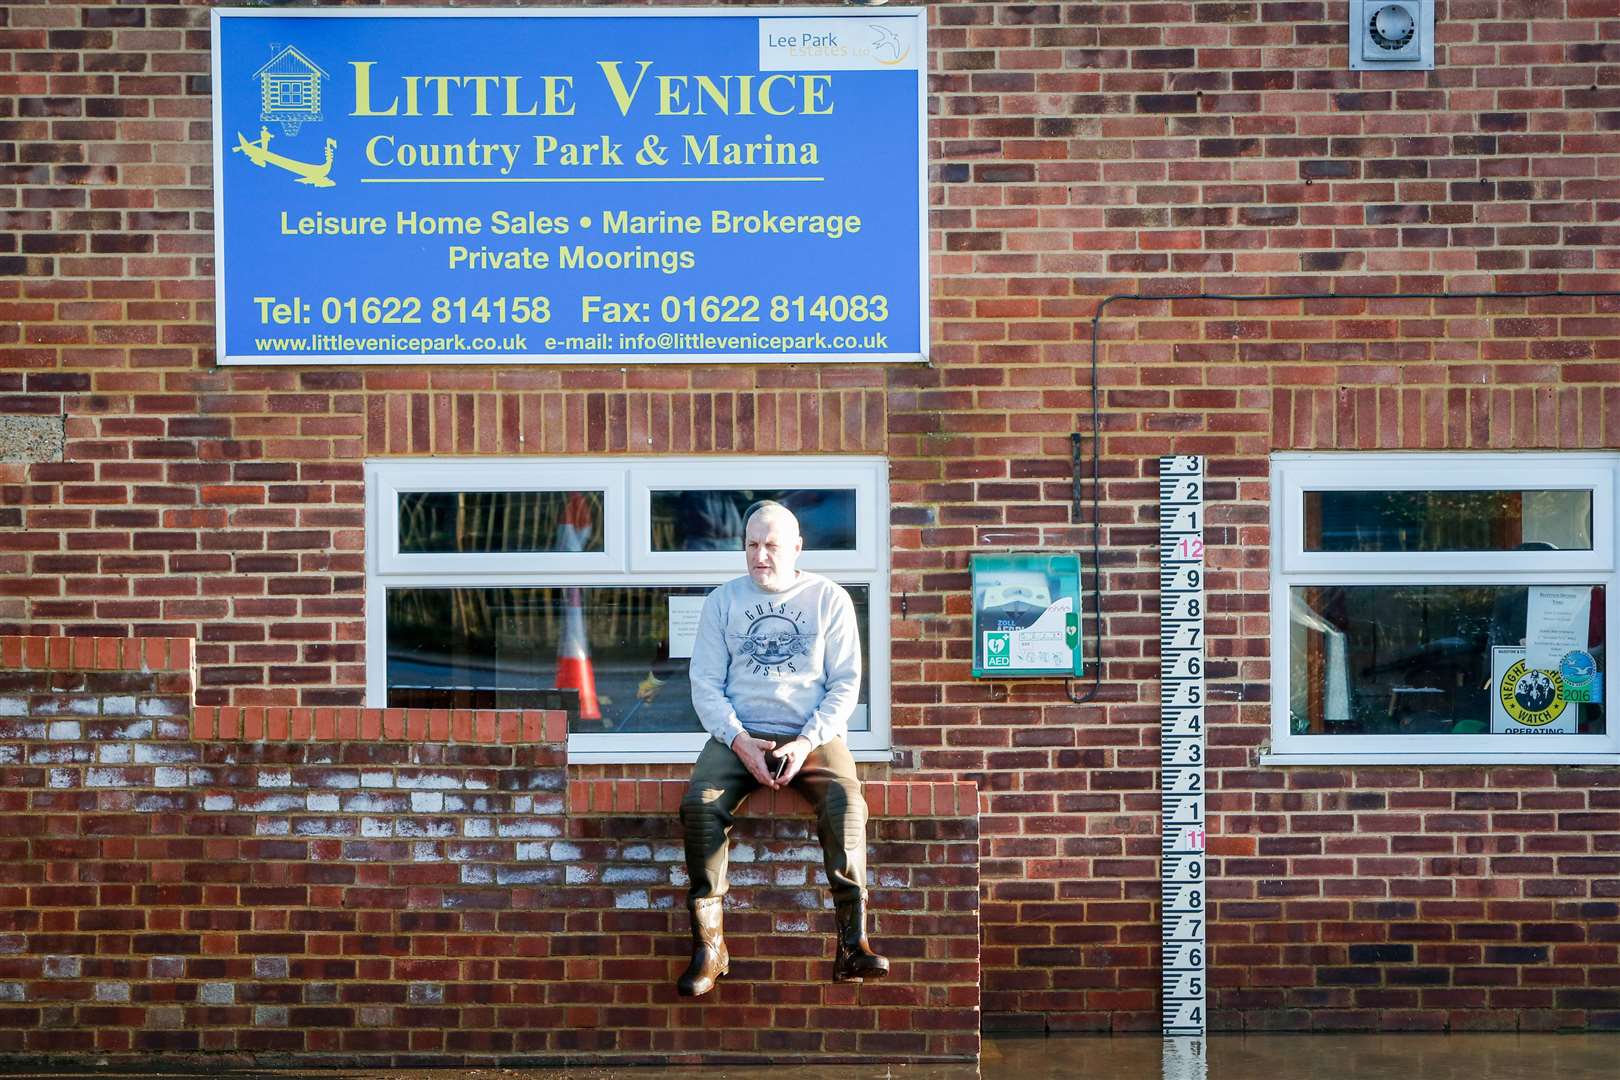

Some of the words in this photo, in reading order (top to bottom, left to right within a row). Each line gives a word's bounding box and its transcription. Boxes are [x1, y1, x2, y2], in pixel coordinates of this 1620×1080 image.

[769, 34, 797, 47] Lee
[802, 33, 838, 47] Park
[789, 45, 848, 57] Estates
[348, 61, 576, 116] LITTLE
[597, 60, 835, 116] VENICE
[365, 136, 521, 174] Country
[533, 136, 624, 165] Park
[636, 135, 668, 165] &
[682, 134, 819, 165] Marina
[281, 211, 387, 235] Leisure
[397, 211, 482, 234] Home
[491, 211, 569, 235] Sales
[603, 210, 701, 234] Marine
[711, 210, 861, 239] Brokerage
[448, 246, 549, 270] Private
[560, 245, 696, 274] Moorings
[254, 297, 311, 324] Tel:
[321, 297, 422, 324] 01622
[431, 296, 550, 324] 814158
[582, 296, 650, 323] Fax:
[661, 296, 761, 323] 01622
[770, 295, 888, 323] 814083
[255, 334, 528, 353] www.littlevenicepark.co.uk
[544, 334, 613, 350] e-mail:
[619, 332, 888, 352] info@littlevenicepark.co.uk
[1187, 456, 1198, 471] 3
[1187, 483, 1198, 500] 2
[1188, 512, 1197, 529] 1
[1179, 540, 1203, 558] 12
[1187, 570, 1199, 587] 9
[1187, 599, 1200, 616] 8
[1187, 629, 1200, 646] 7
[988, 656, 1010, 666] AED
[1187, 657, 1200, 675] 6
[1188, 686, 1200, 703] 5
[1564, 689, 1590, 702] 2016
[1187, 715, 1200, 732] 4
[1518, 709, 1552, 724] WATCH
[1188, 745, 1200, 762] 3
[1188, 773, 1200, 791] 2
[1189, 803, 1198, 820] 1
[1188, 831, 1205, 849] 11
[1189, 861, 1201, 879] 9
[1189, 891, 1201, 908] 8
[1189, 920, 1201, 937] 7
[1189, 949, 1201, 967] 6
[1189, 978, 1201, 995] 5
[1189, 1007, 1202, 1024] 4
